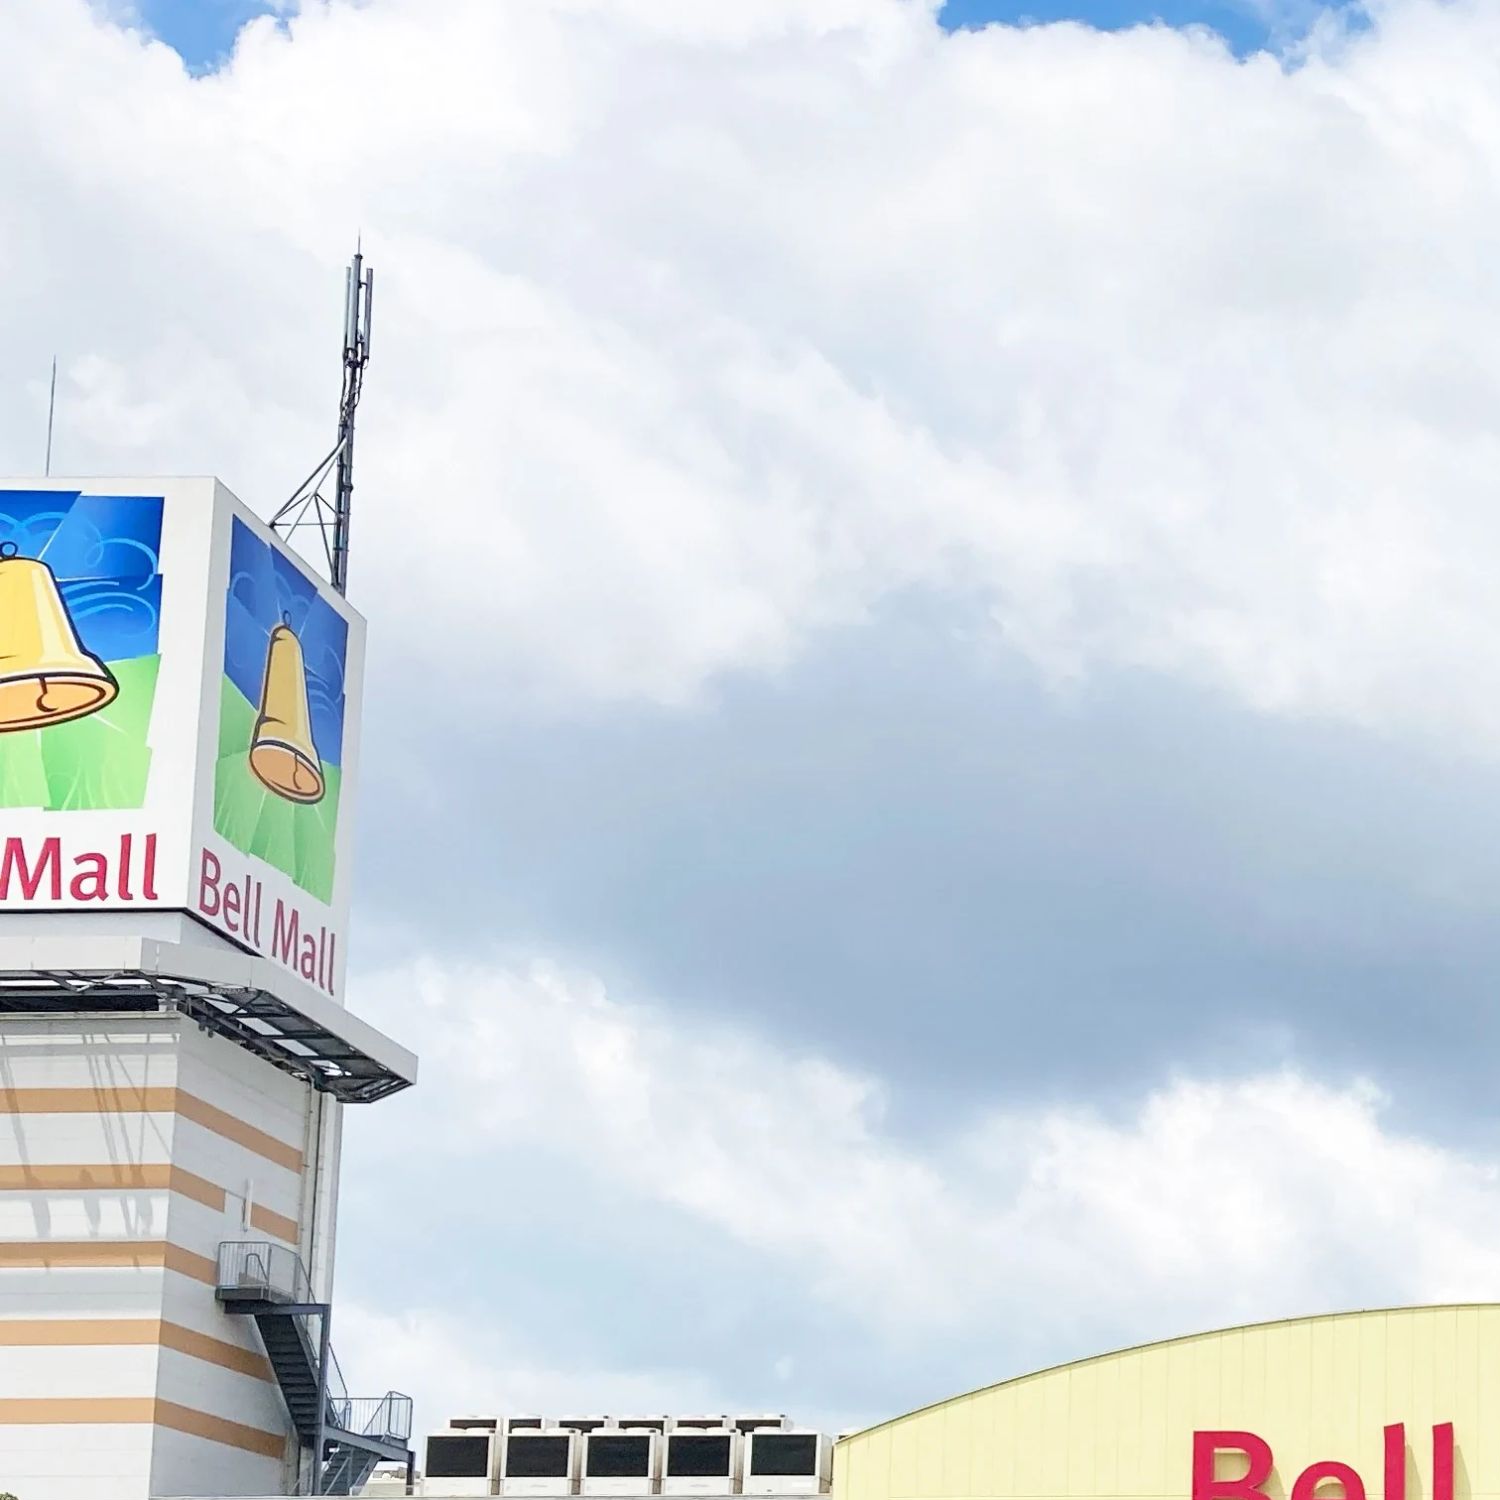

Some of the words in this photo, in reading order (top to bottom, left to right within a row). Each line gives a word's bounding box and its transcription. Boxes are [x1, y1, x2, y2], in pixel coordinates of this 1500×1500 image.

[0, 832, 158, 901] Mall
[199, 847, 262, 948] Bell
[271, 899, 336, 996] Mall
